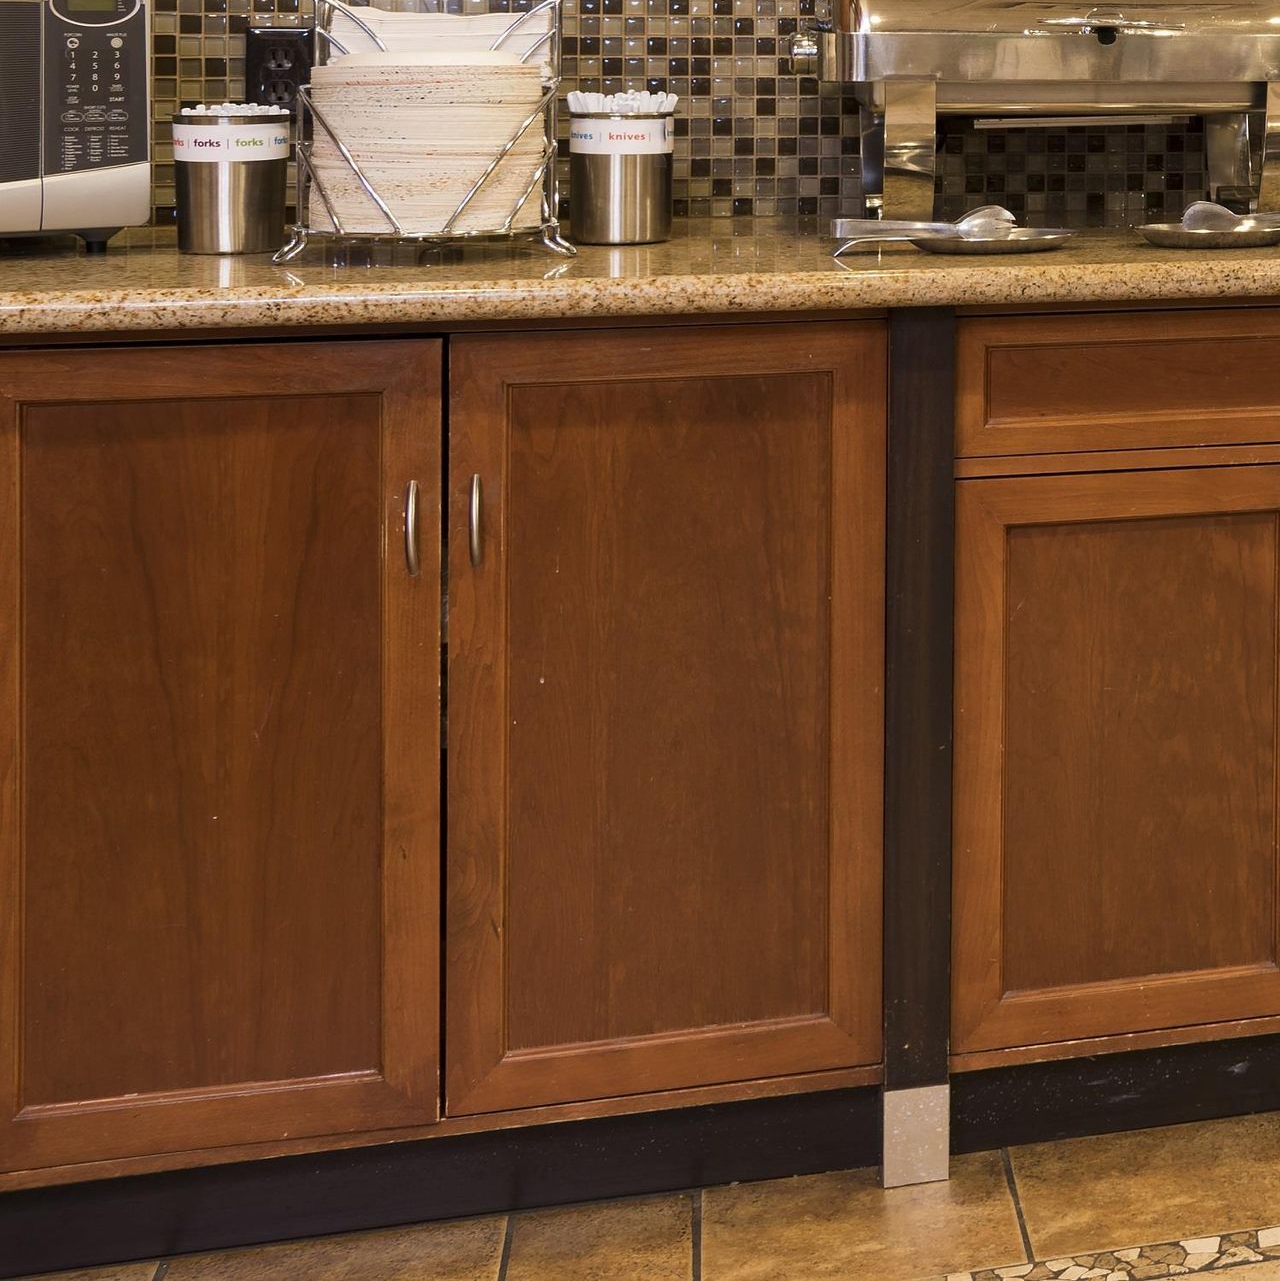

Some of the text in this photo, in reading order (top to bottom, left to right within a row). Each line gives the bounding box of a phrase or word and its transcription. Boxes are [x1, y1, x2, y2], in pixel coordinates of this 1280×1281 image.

[70, 51, 120, 59] 1 2 3
[69, 62, 76, 70] 4
[92, 62, 98, 70] 5
[70, 73, 120, 81] 7 8 9
[92, 84, 98, 92] 0
[608, 132, 646, 141] knives
[193, 138, 221, 148] forks
[235, 137, 264, 148] forks
